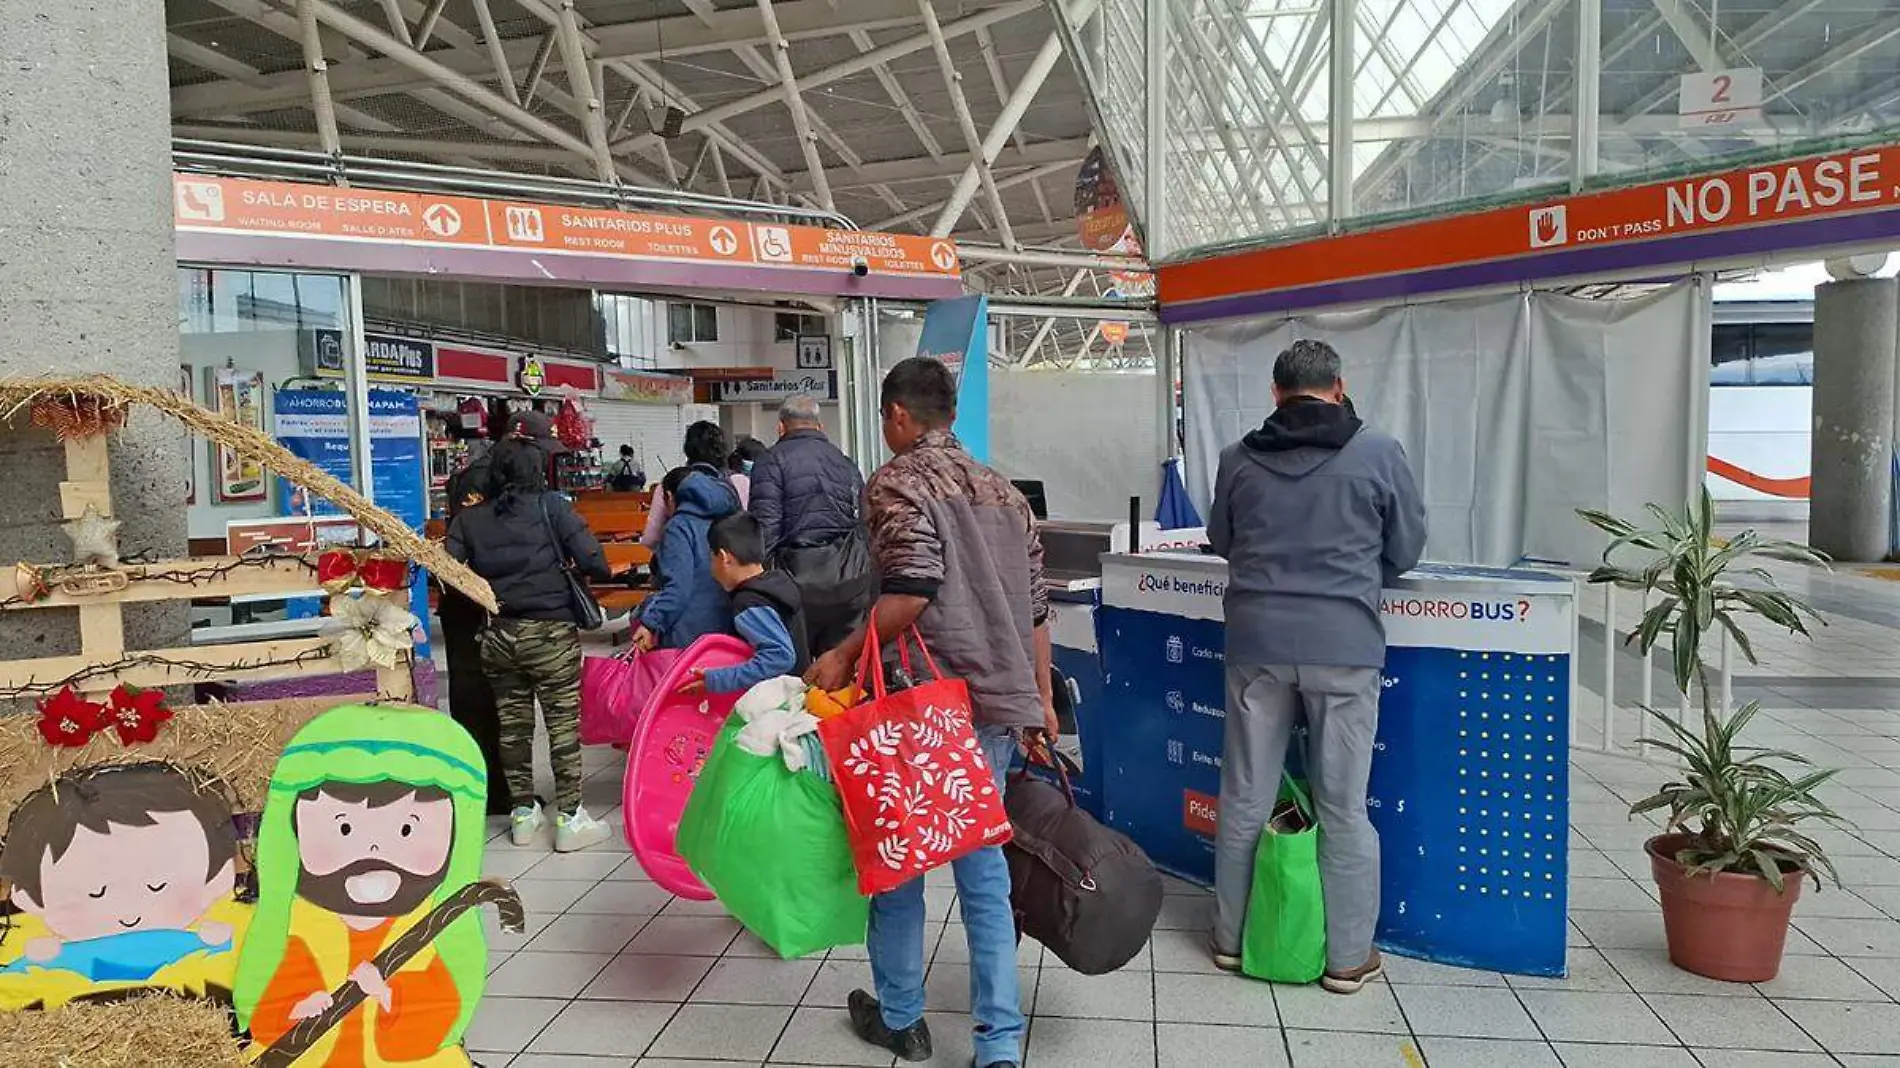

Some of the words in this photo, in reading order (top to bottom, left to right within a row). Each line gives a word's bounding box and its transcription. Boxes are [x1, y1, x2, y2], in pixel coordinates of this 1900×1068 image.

[1710, 75, 1732, 103] 2
[1666, 178, 1732, 228] NO
[1748, 153, 1882, 217] PASE
[242, 190, 297, 208] SALA
[303, 196, 330, 210] DE
[335, 198, 412, 216] ESPERA
[561, 214, 652, 234] SANITARIOS
[655, 221, 693, 237] PLUS
[1624, 219, 1662, 235] PASS
[595, 239, 625, 250] ROOM
[827, 231, 896, 248] SANITARIOS
[819, 243, 905, 260] MINUSVALIDOS
[747, 380, 799, 393] Sanitarios
[800, 376, 825, 393] Plus
[1138, 573, 1170, 594] ¿Qué
[1190, 800, 1217, 821] Pide
